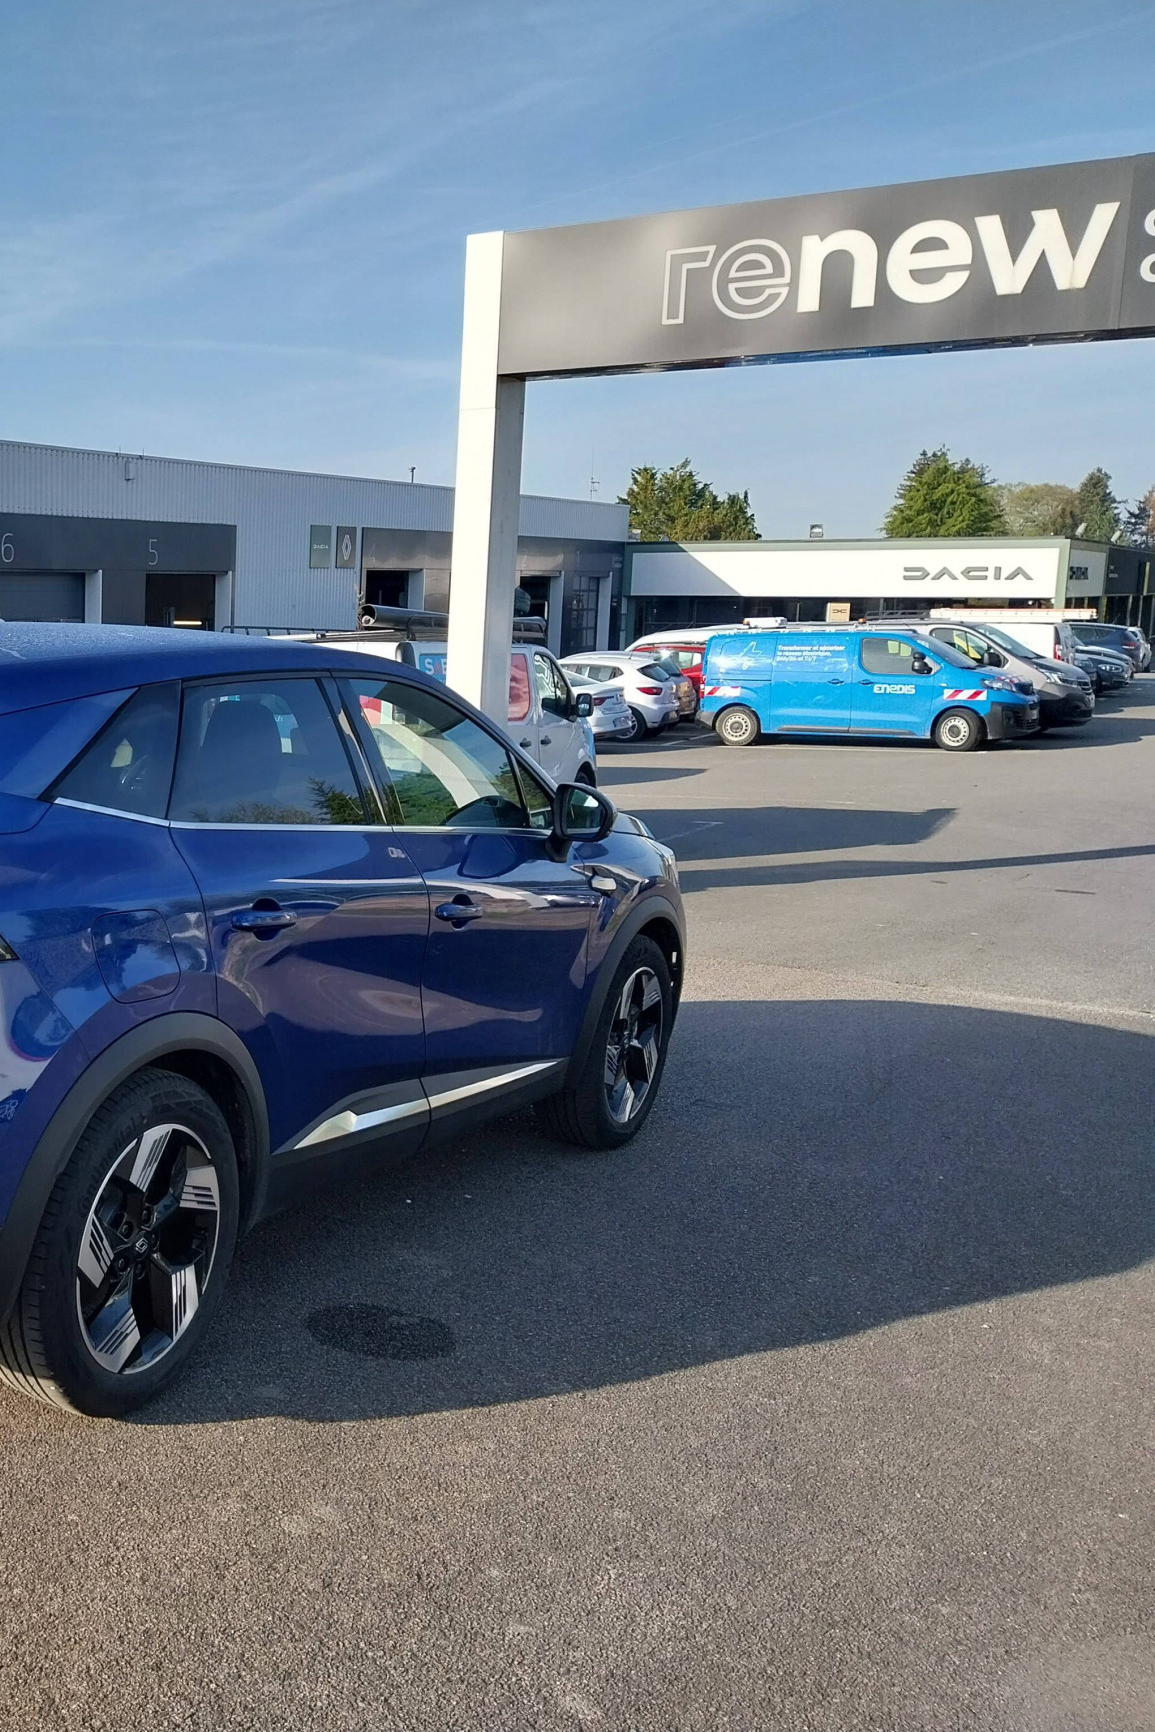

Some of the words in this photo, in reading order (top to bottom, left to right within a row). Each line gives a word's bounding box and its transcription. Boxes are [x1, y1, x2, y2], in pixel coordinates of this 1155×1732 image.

[661, 201, 1121, 326] renew
[1, 532, 15, 563] 6
[148, 538, 159, 566] 5
[902, 566, 1034, 581] DACIA
